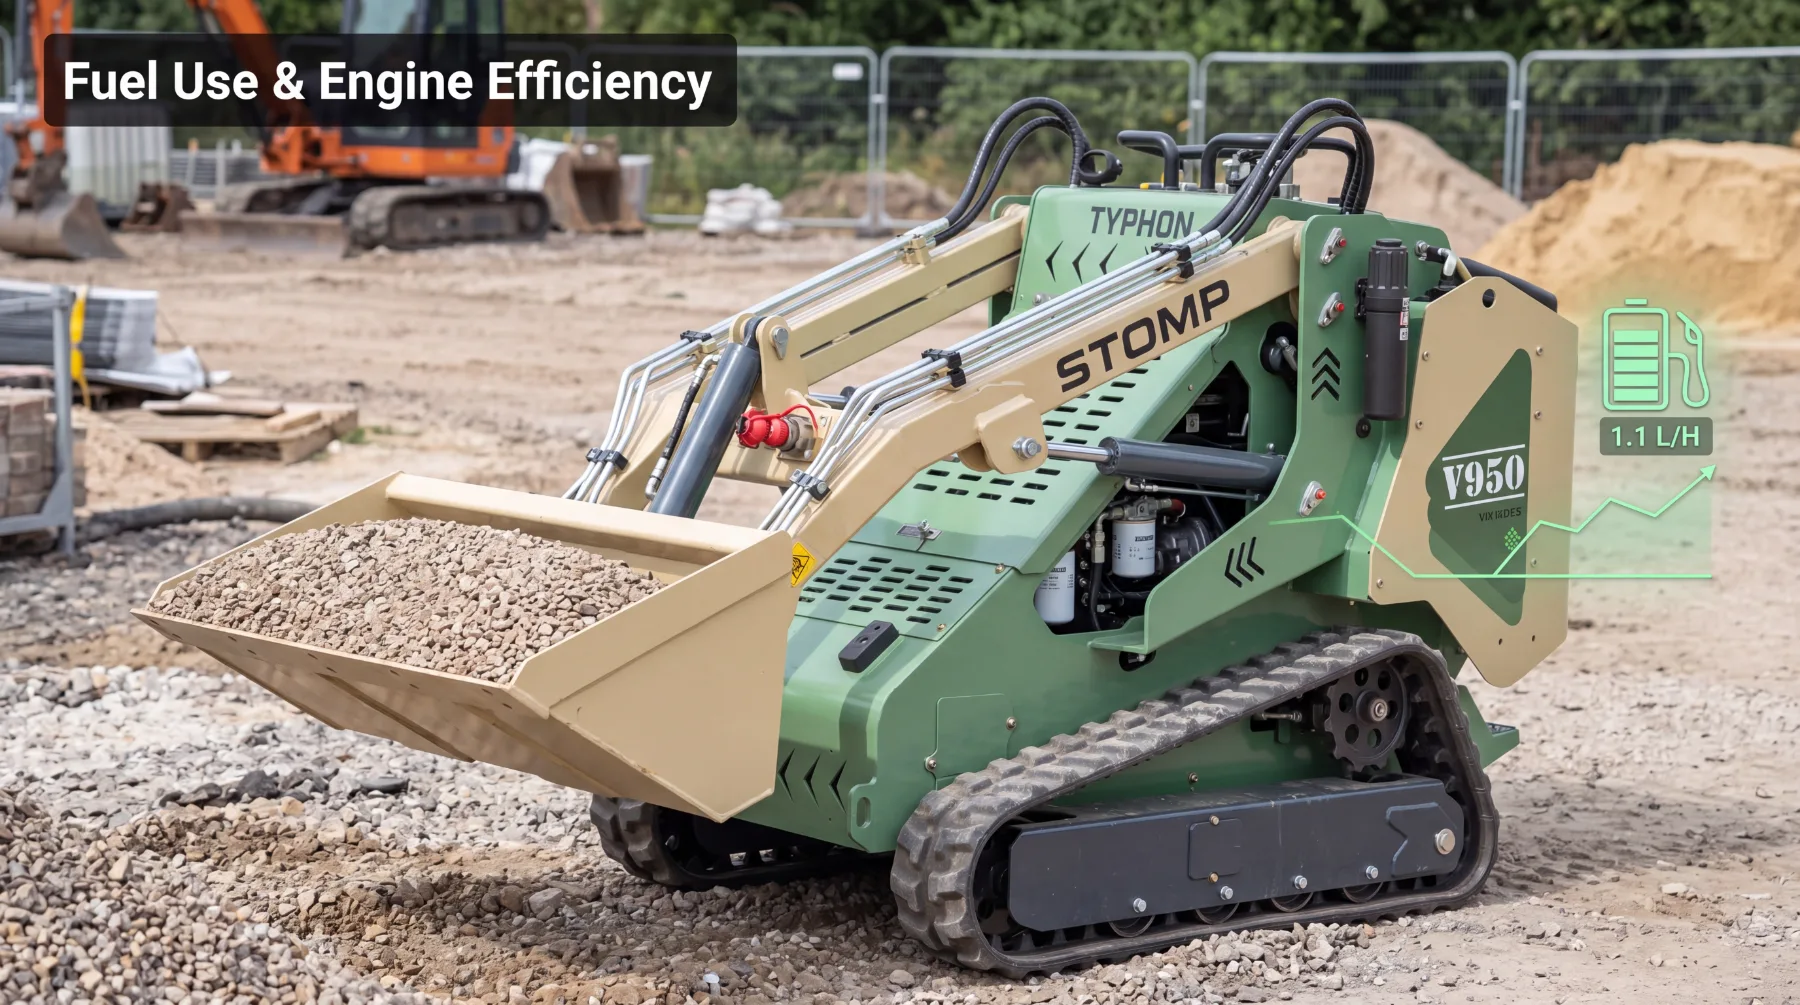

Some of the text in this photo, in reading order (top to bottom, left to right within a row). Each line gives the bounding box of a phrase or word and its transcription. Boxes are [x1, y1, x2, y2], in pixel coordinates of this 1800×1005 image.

[1091, 206, 1195, 239] TYPHON
[1056, 279, 1230, 393] STOMP
[1442, 454, 1525, 501] V950
